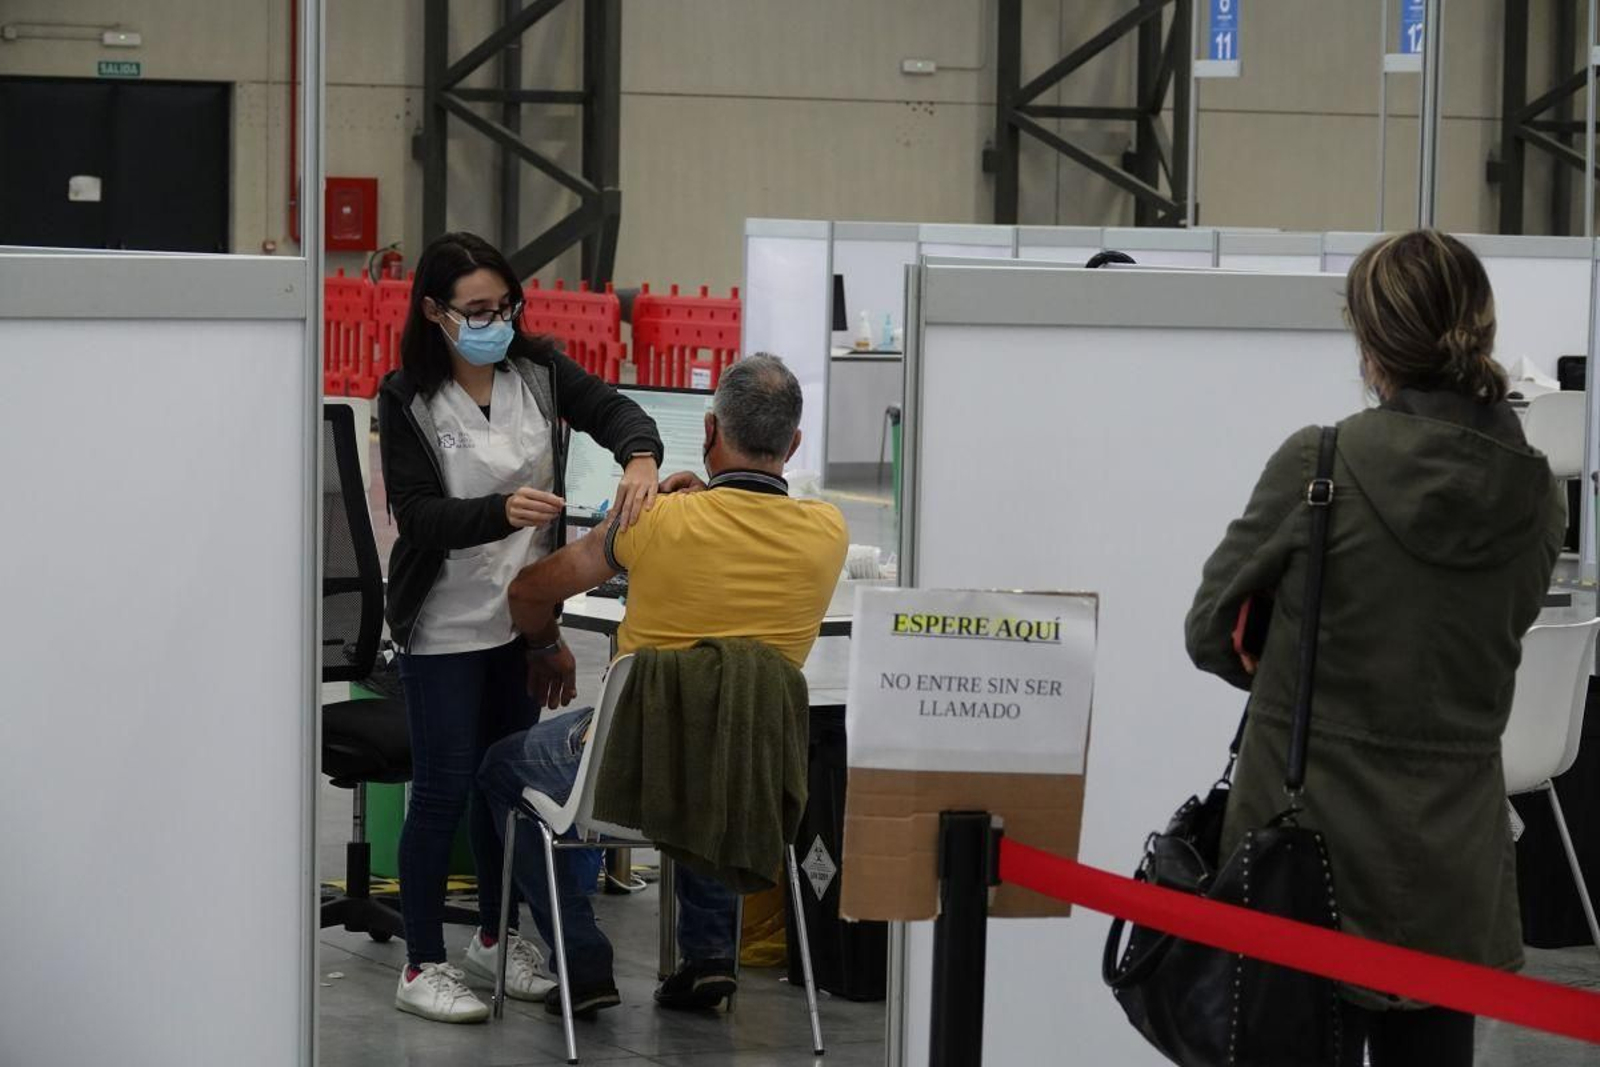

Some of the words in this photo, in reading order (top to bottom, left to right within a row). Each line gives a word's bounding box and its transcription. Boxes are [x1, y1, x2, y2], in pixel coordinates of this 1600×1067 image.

[1216, 32, 1231, 59] 11
[100, 63, 138, 75] SALIDA
[892, 613, 990, 638] ESPERE
[996, 617, 1062, 643] AQUÍ
[880, 672, 911, 690] NO
[916, 674, 982, 694] ENTRE
[987, 677, 1019, 695] SIN
[1024, 679, 1062, 697] SER
[919, 699, 1021, 719] LLAMADO
